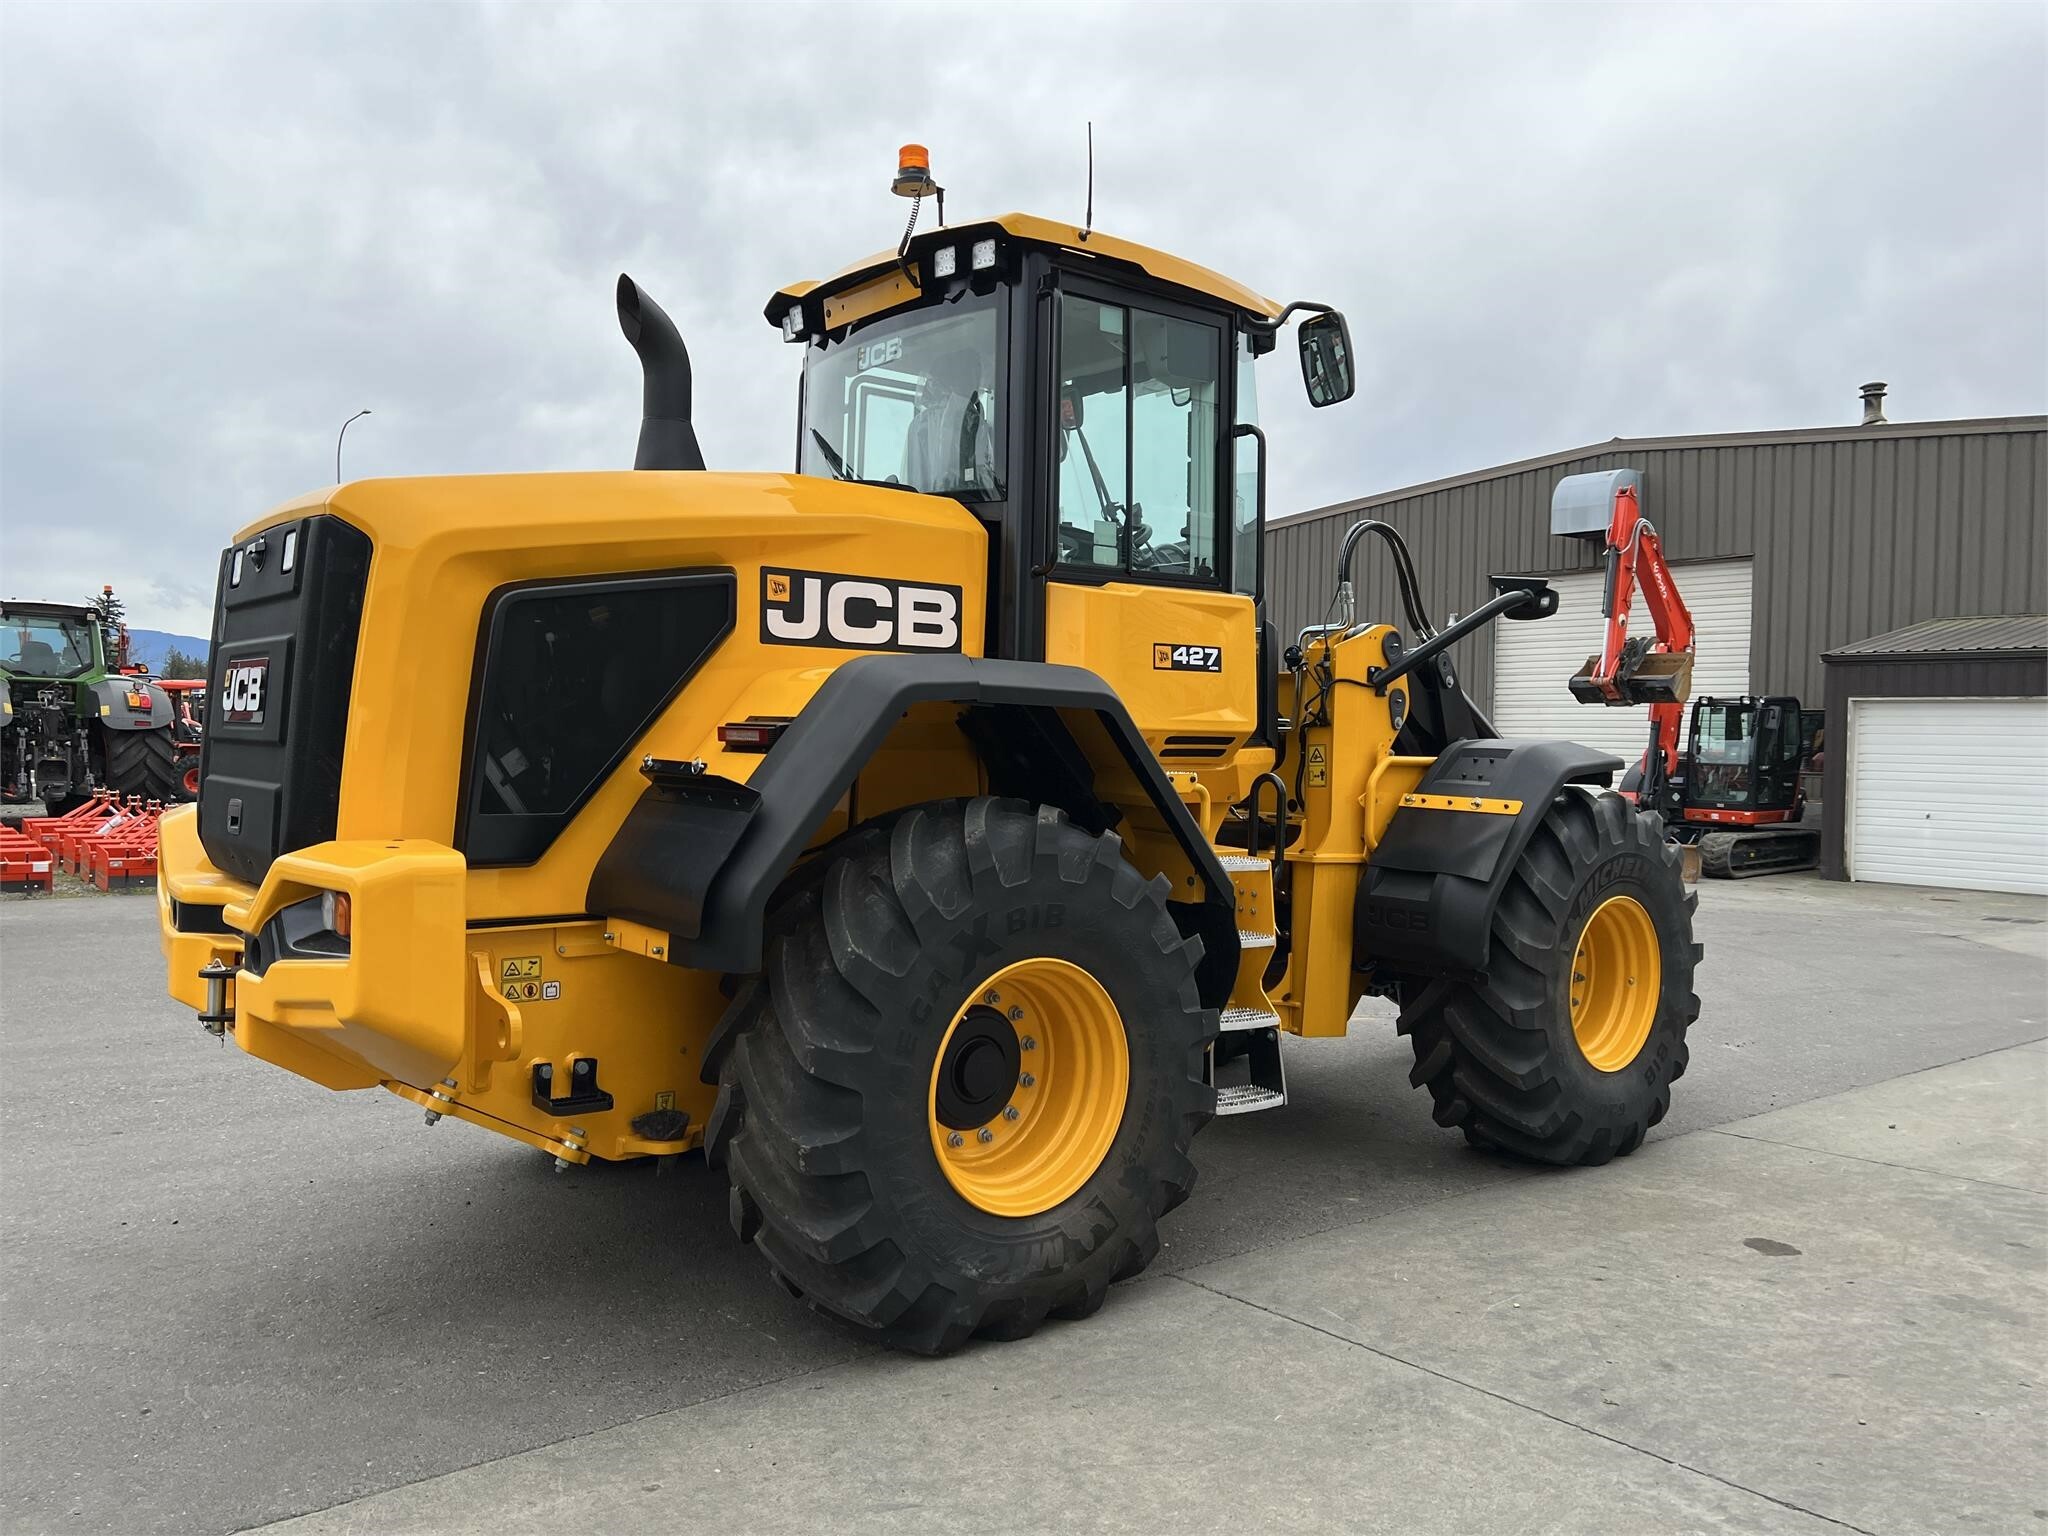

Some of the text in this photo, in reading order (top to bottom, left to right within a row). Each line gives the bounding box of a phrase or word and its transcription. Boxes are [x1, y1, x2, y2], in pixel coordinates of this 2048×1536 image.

[859, 337, 902, 370] JCB
[766, 577, 958, 648] JCB
[1173, 646, 1219, 666] 427
[223, 666, 262, 712] JCB
